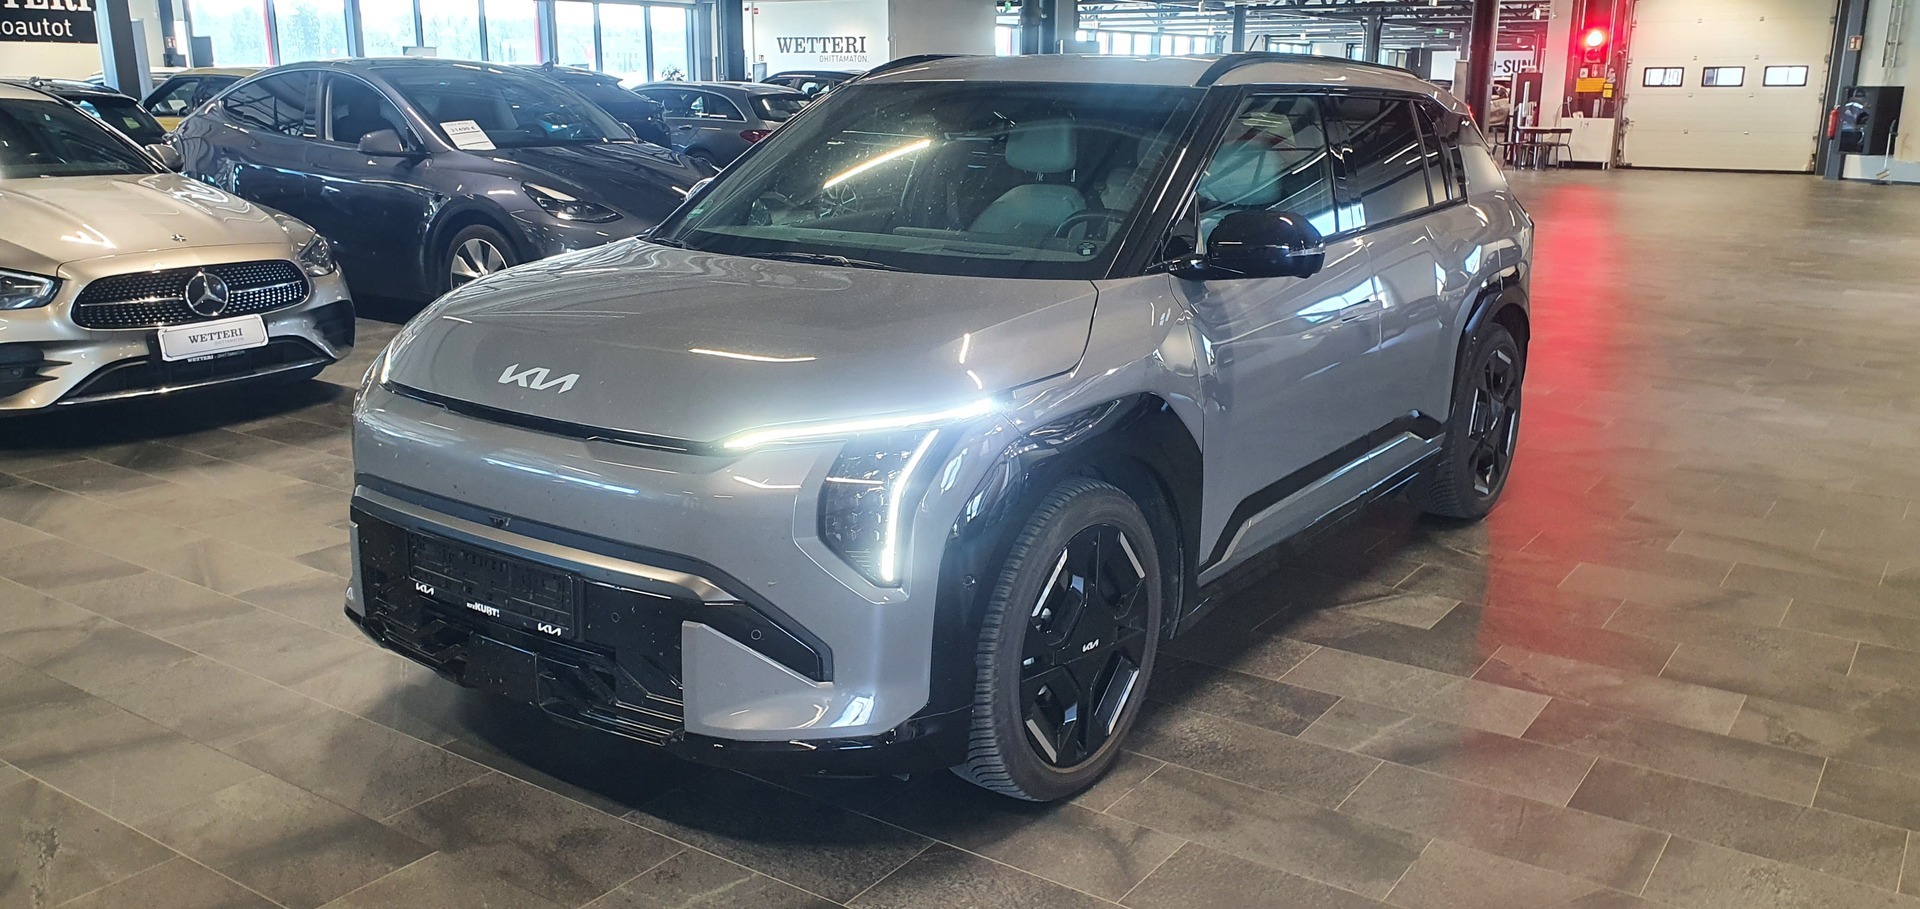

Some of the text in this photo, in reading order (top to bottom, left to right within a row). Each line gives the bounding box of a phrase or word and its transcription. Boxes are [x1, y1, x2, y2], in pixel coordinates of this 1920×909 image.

[0, 18, 73, 36] oautot
[777, 37, 866, 53] WETTERI
[188, 328, 243, 344] WETTERI
[497, 363, 580, 394] KIA
